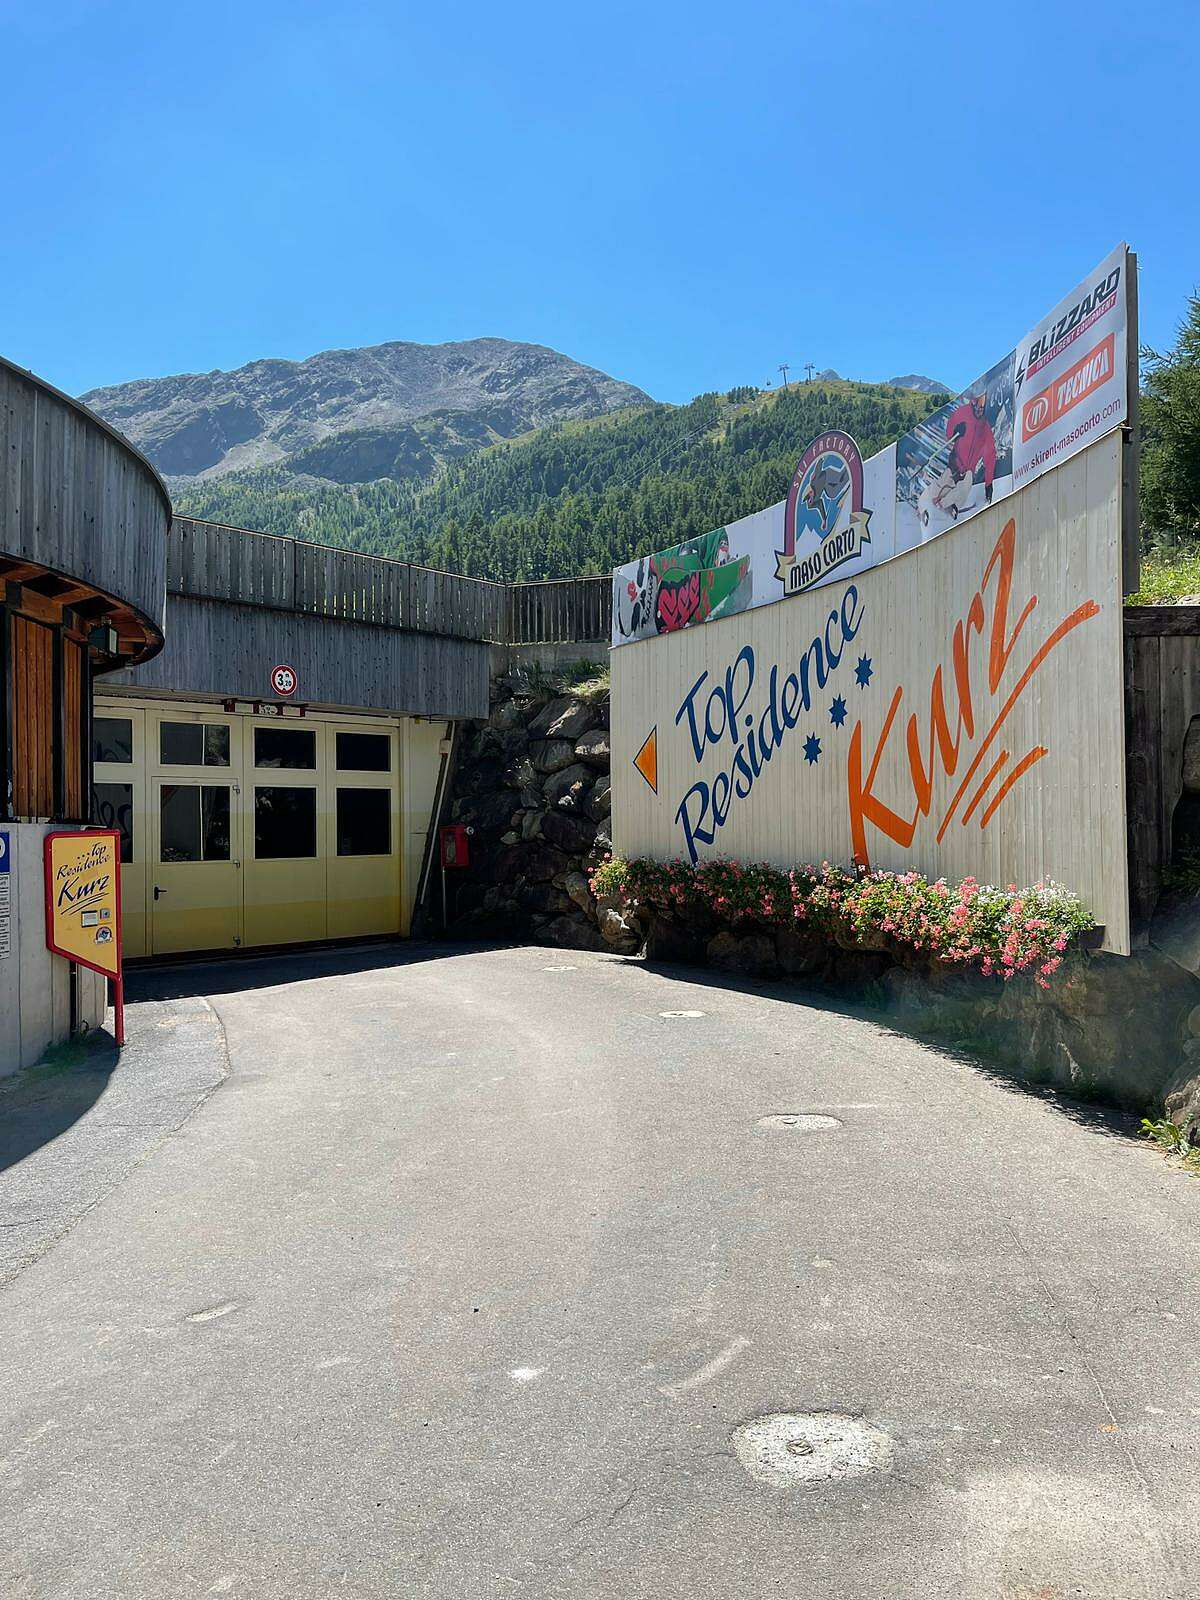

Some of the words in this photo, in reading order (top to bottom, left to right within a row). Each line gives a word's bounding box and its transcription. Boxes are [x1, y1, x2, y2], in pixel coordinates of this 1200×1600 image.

[1036, 330, 1076, 370] INTELLIGENT
[1076, 295, 1116, 338] EQUIPMENT
[1057, 347, 1109, 411] TECNICA
[812, 436, 856, 464] FACTORY
[1014, 398, 1121, 480] www.skirent-masocorto.com
[790, 554, 822, 590] MASO
[823, 527, 856, 568] CORTO
[675, 583, 866, 867] Residence
[849, 517, 1039, 875] Kurz
[57, 853, 110, 881] Residence
[57, 875, 110, 907] Kurz
